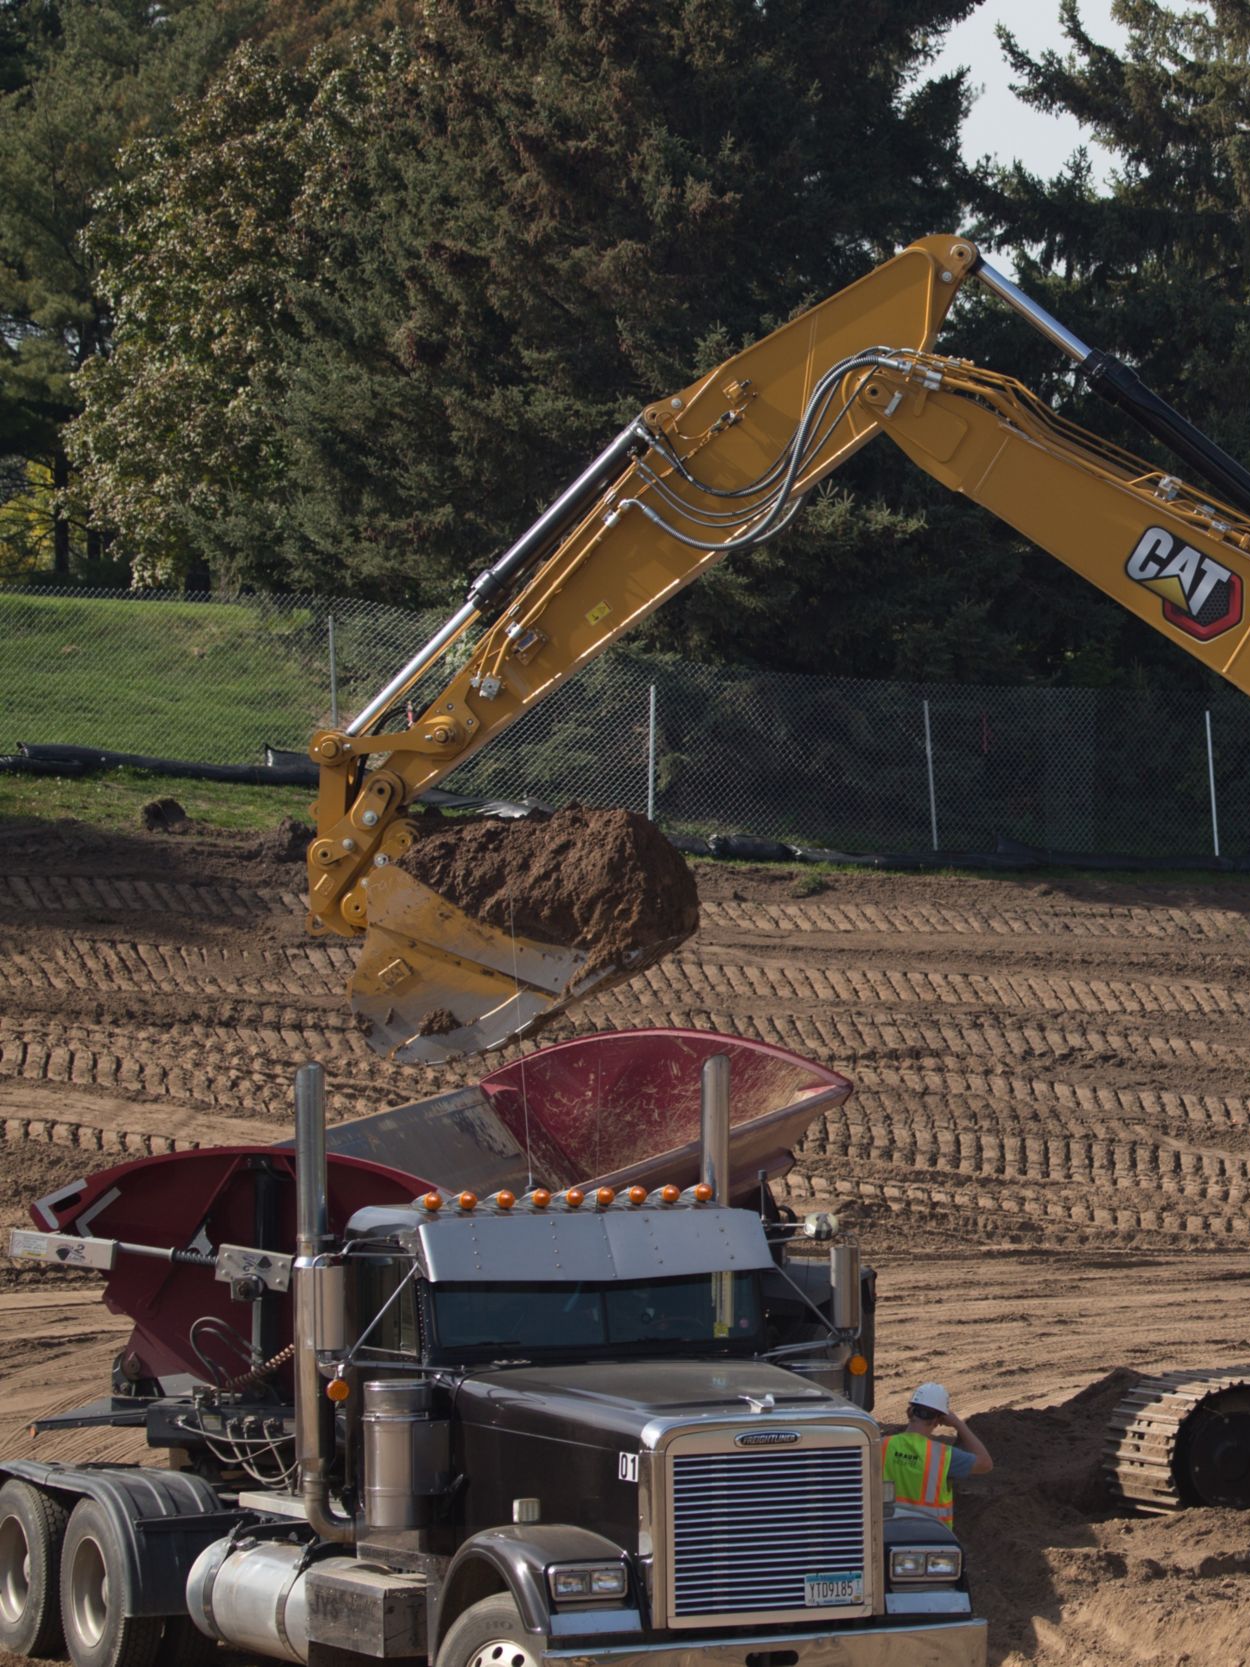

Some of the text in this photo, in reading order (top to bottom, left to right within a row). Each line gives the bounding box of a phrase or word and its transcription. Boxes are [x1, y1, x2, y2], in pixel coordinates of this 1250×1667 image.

[1127, 526, 1232, 616] CAT
[742, 1434, 798, 1445] FREIGHTLINER
[621, 1454, 636, 1480] 01
